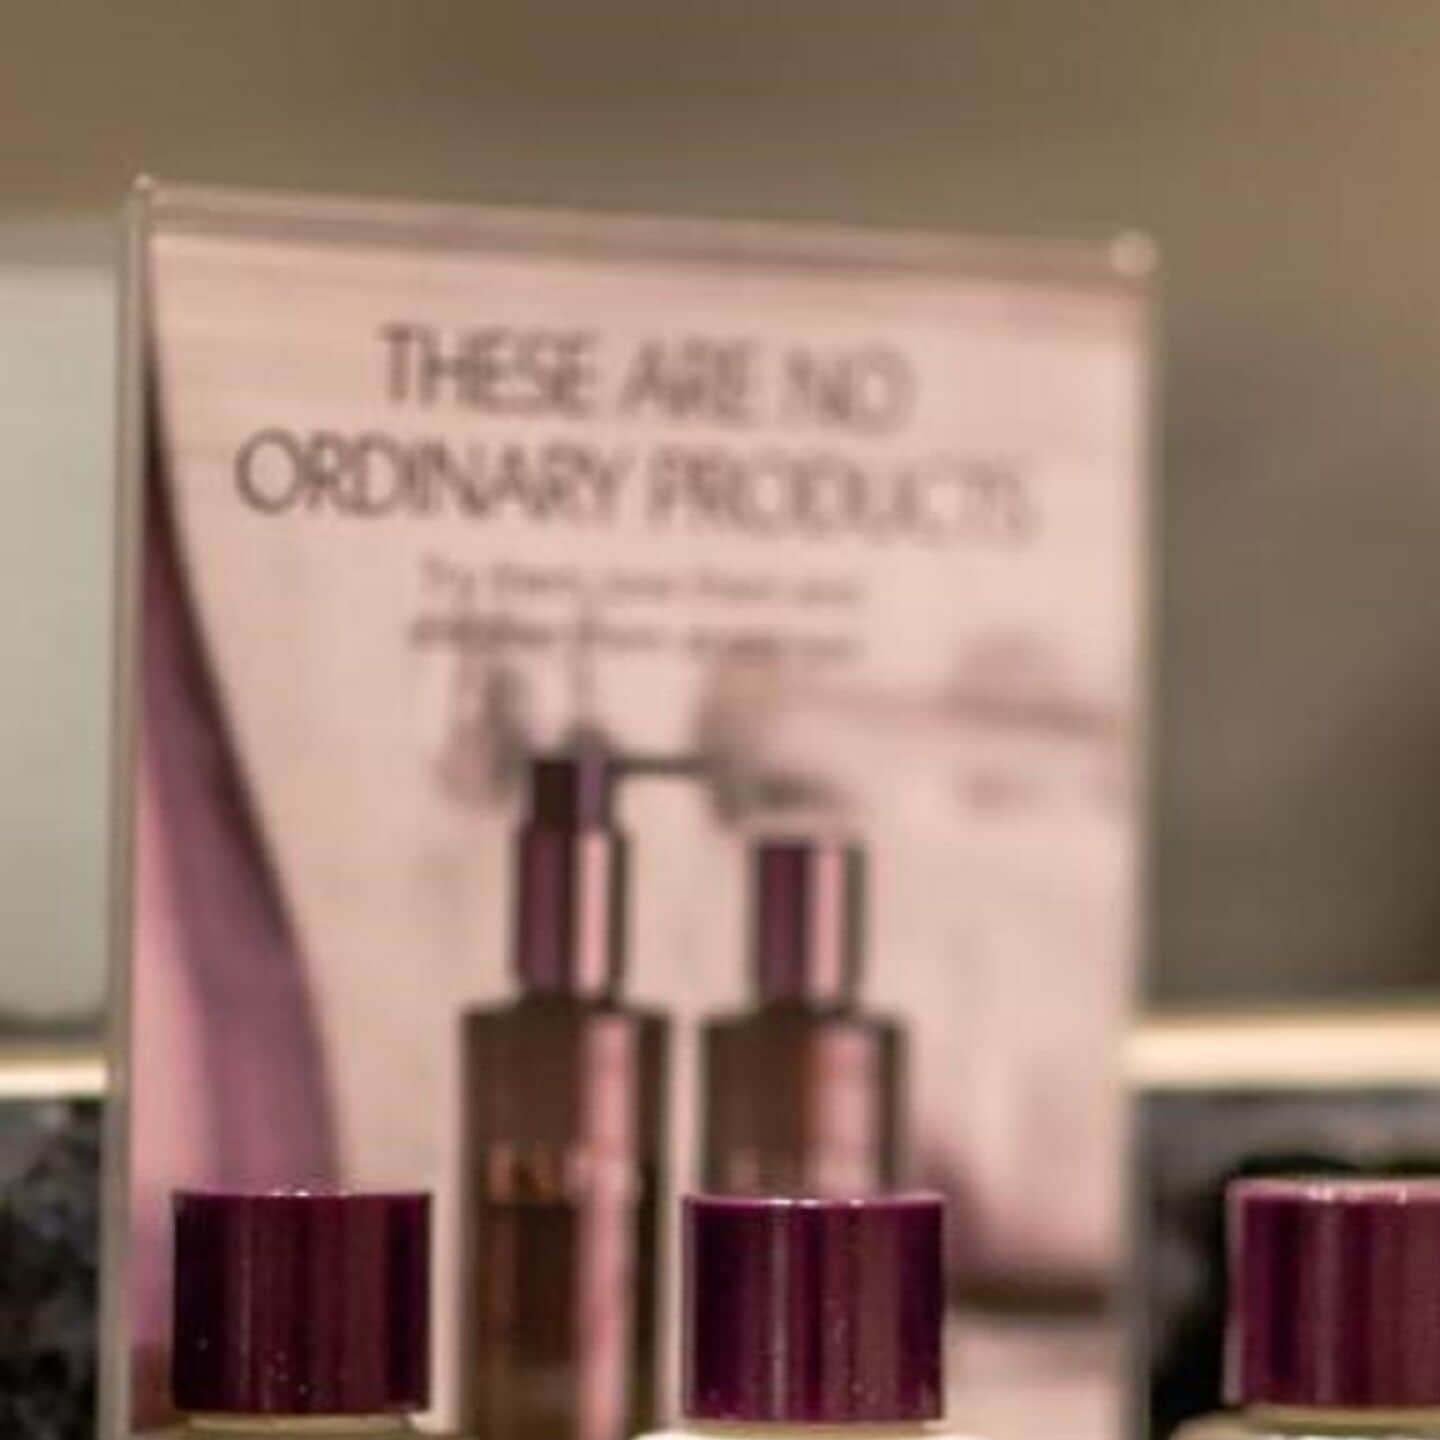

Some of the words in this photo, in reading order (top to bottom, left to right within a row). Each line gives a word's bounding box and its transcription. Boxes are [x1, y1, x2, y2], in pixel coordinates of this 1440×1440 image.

[380, 322, 598, 416] THESE
[616, 336, 756, 426] ARE
[782, 340, 916, 434] NO
[232, 426, 630, 526] ORDINARY
[644, 445, 1042, 544] PRODUCTS
